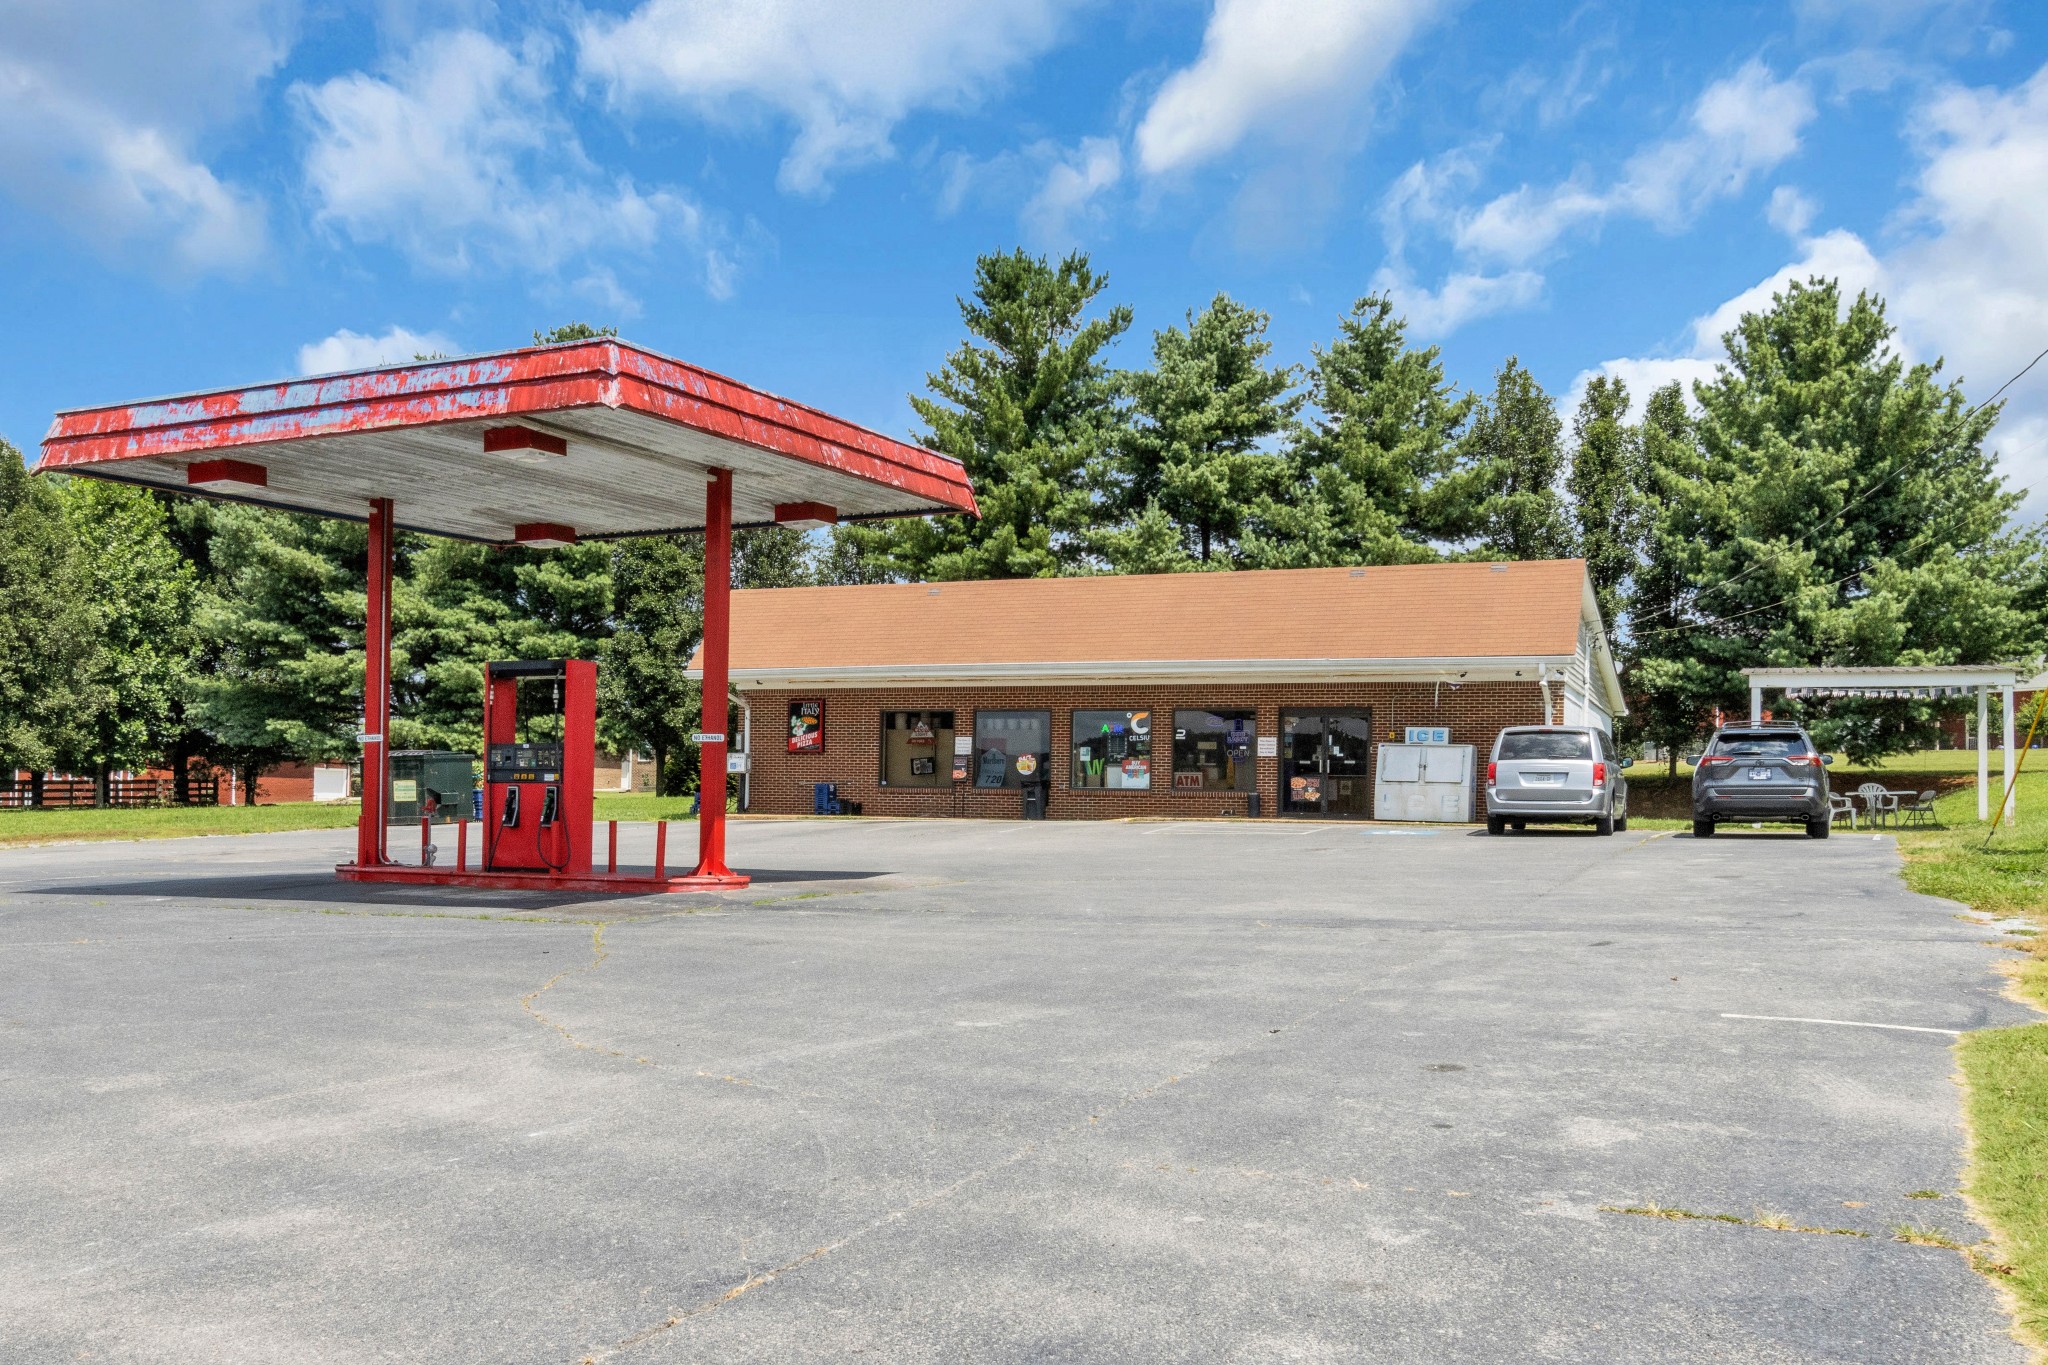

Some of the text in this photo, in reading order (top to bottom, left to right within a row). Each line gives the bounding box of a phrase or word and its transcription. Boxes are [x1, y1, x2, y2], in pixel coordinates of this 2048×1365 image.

[801, 707, 820, 716] ITALY
[791, 732, 818, 743] DELICIOUS
[1409, 730, 1444, 741] ICE
[796, 739, 813, 748] PIZZA
[985, 775, 1003, 784] 720
[1176, 775, 1200, 786] ATM
